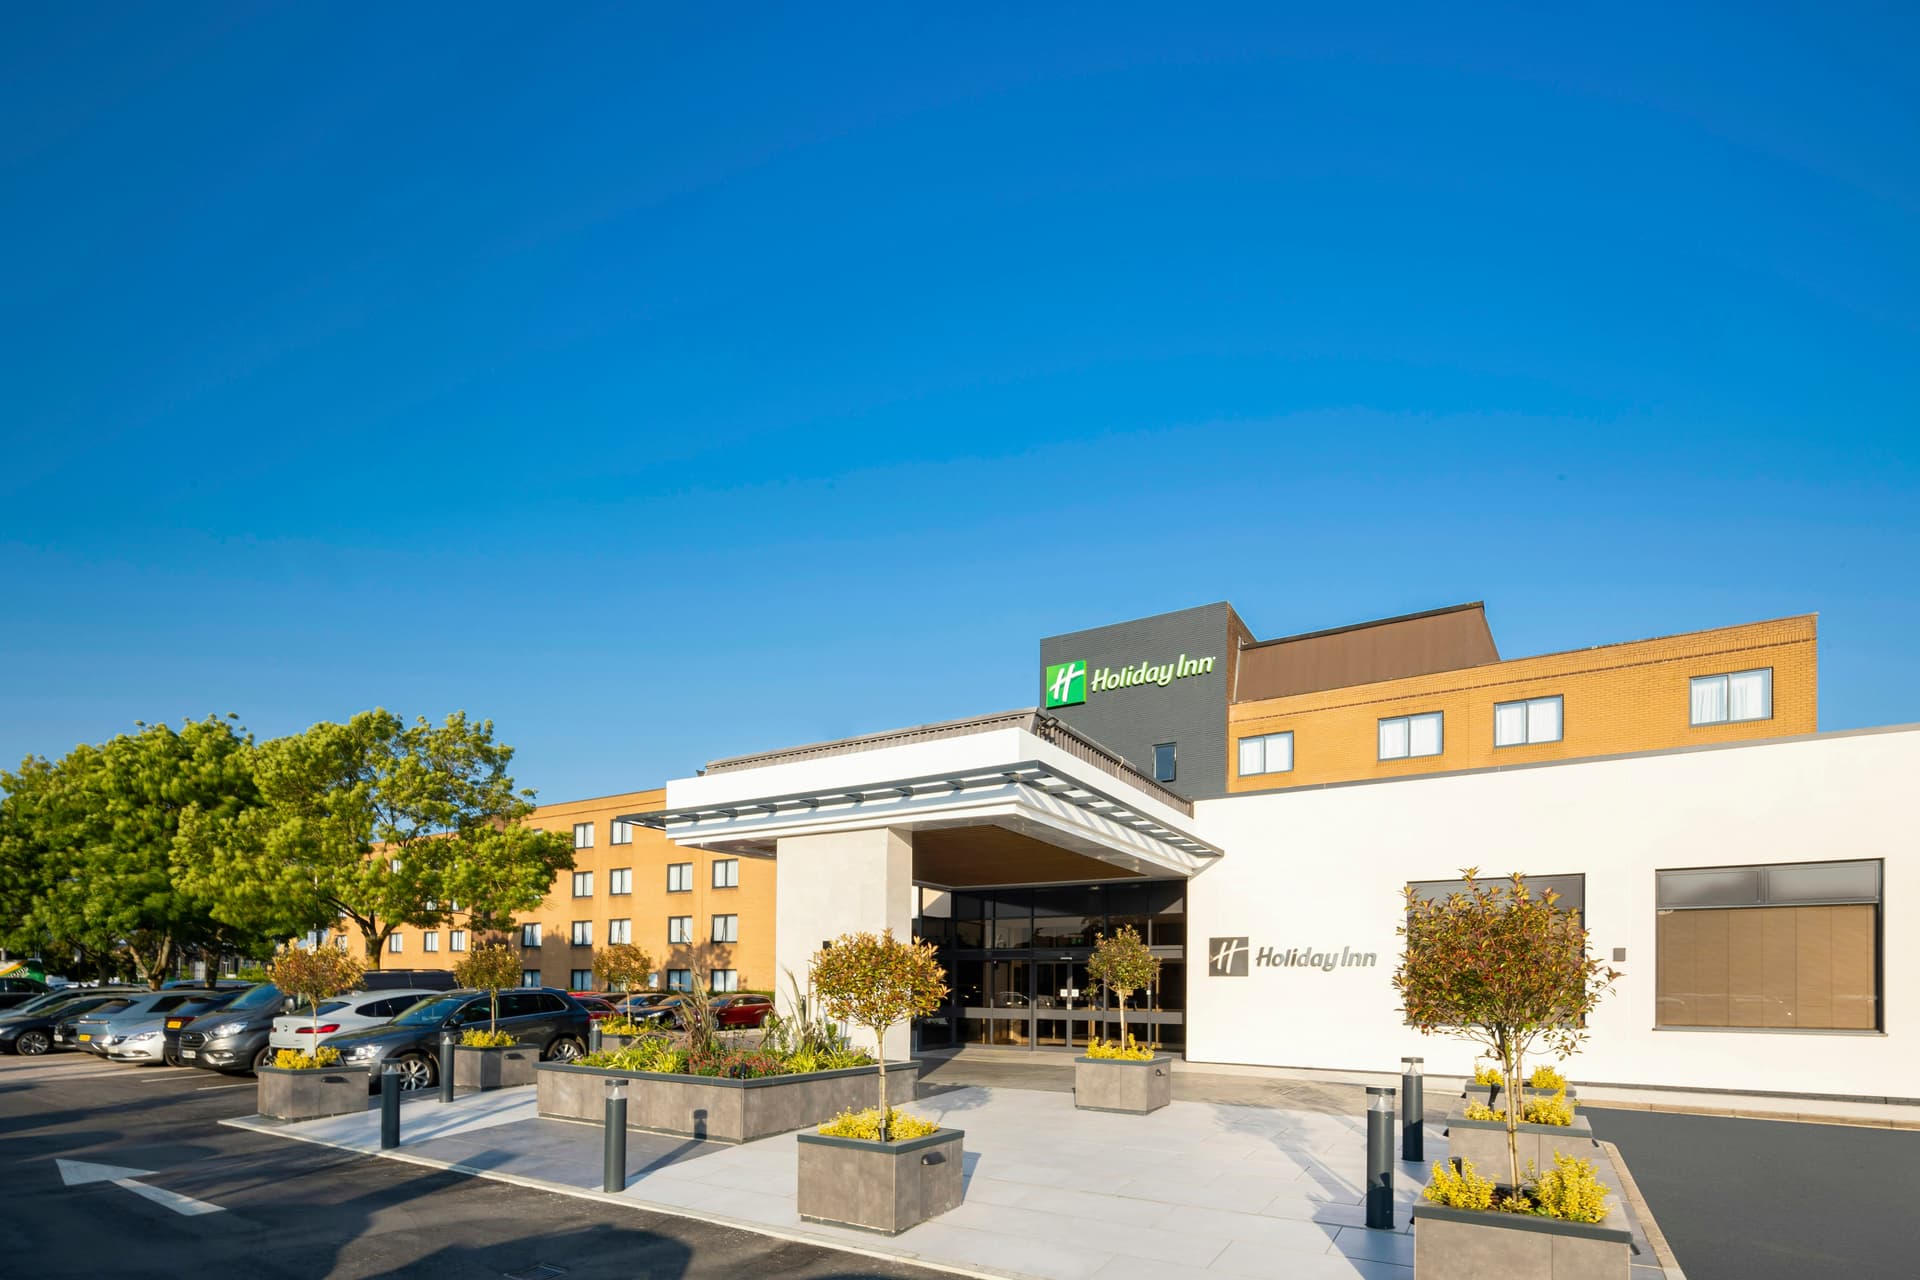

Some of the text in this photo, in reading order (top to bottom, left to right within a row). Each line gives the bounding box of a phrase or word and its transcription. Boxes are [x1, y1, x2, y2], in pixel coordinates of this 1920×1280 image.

[1091, 661, 1175, 692] Holiday
[1176, 653, 1213, 678] Inn
[1256, 946, 1339, 972] Holiday
[1340, 945, 1377, 967] Inn
